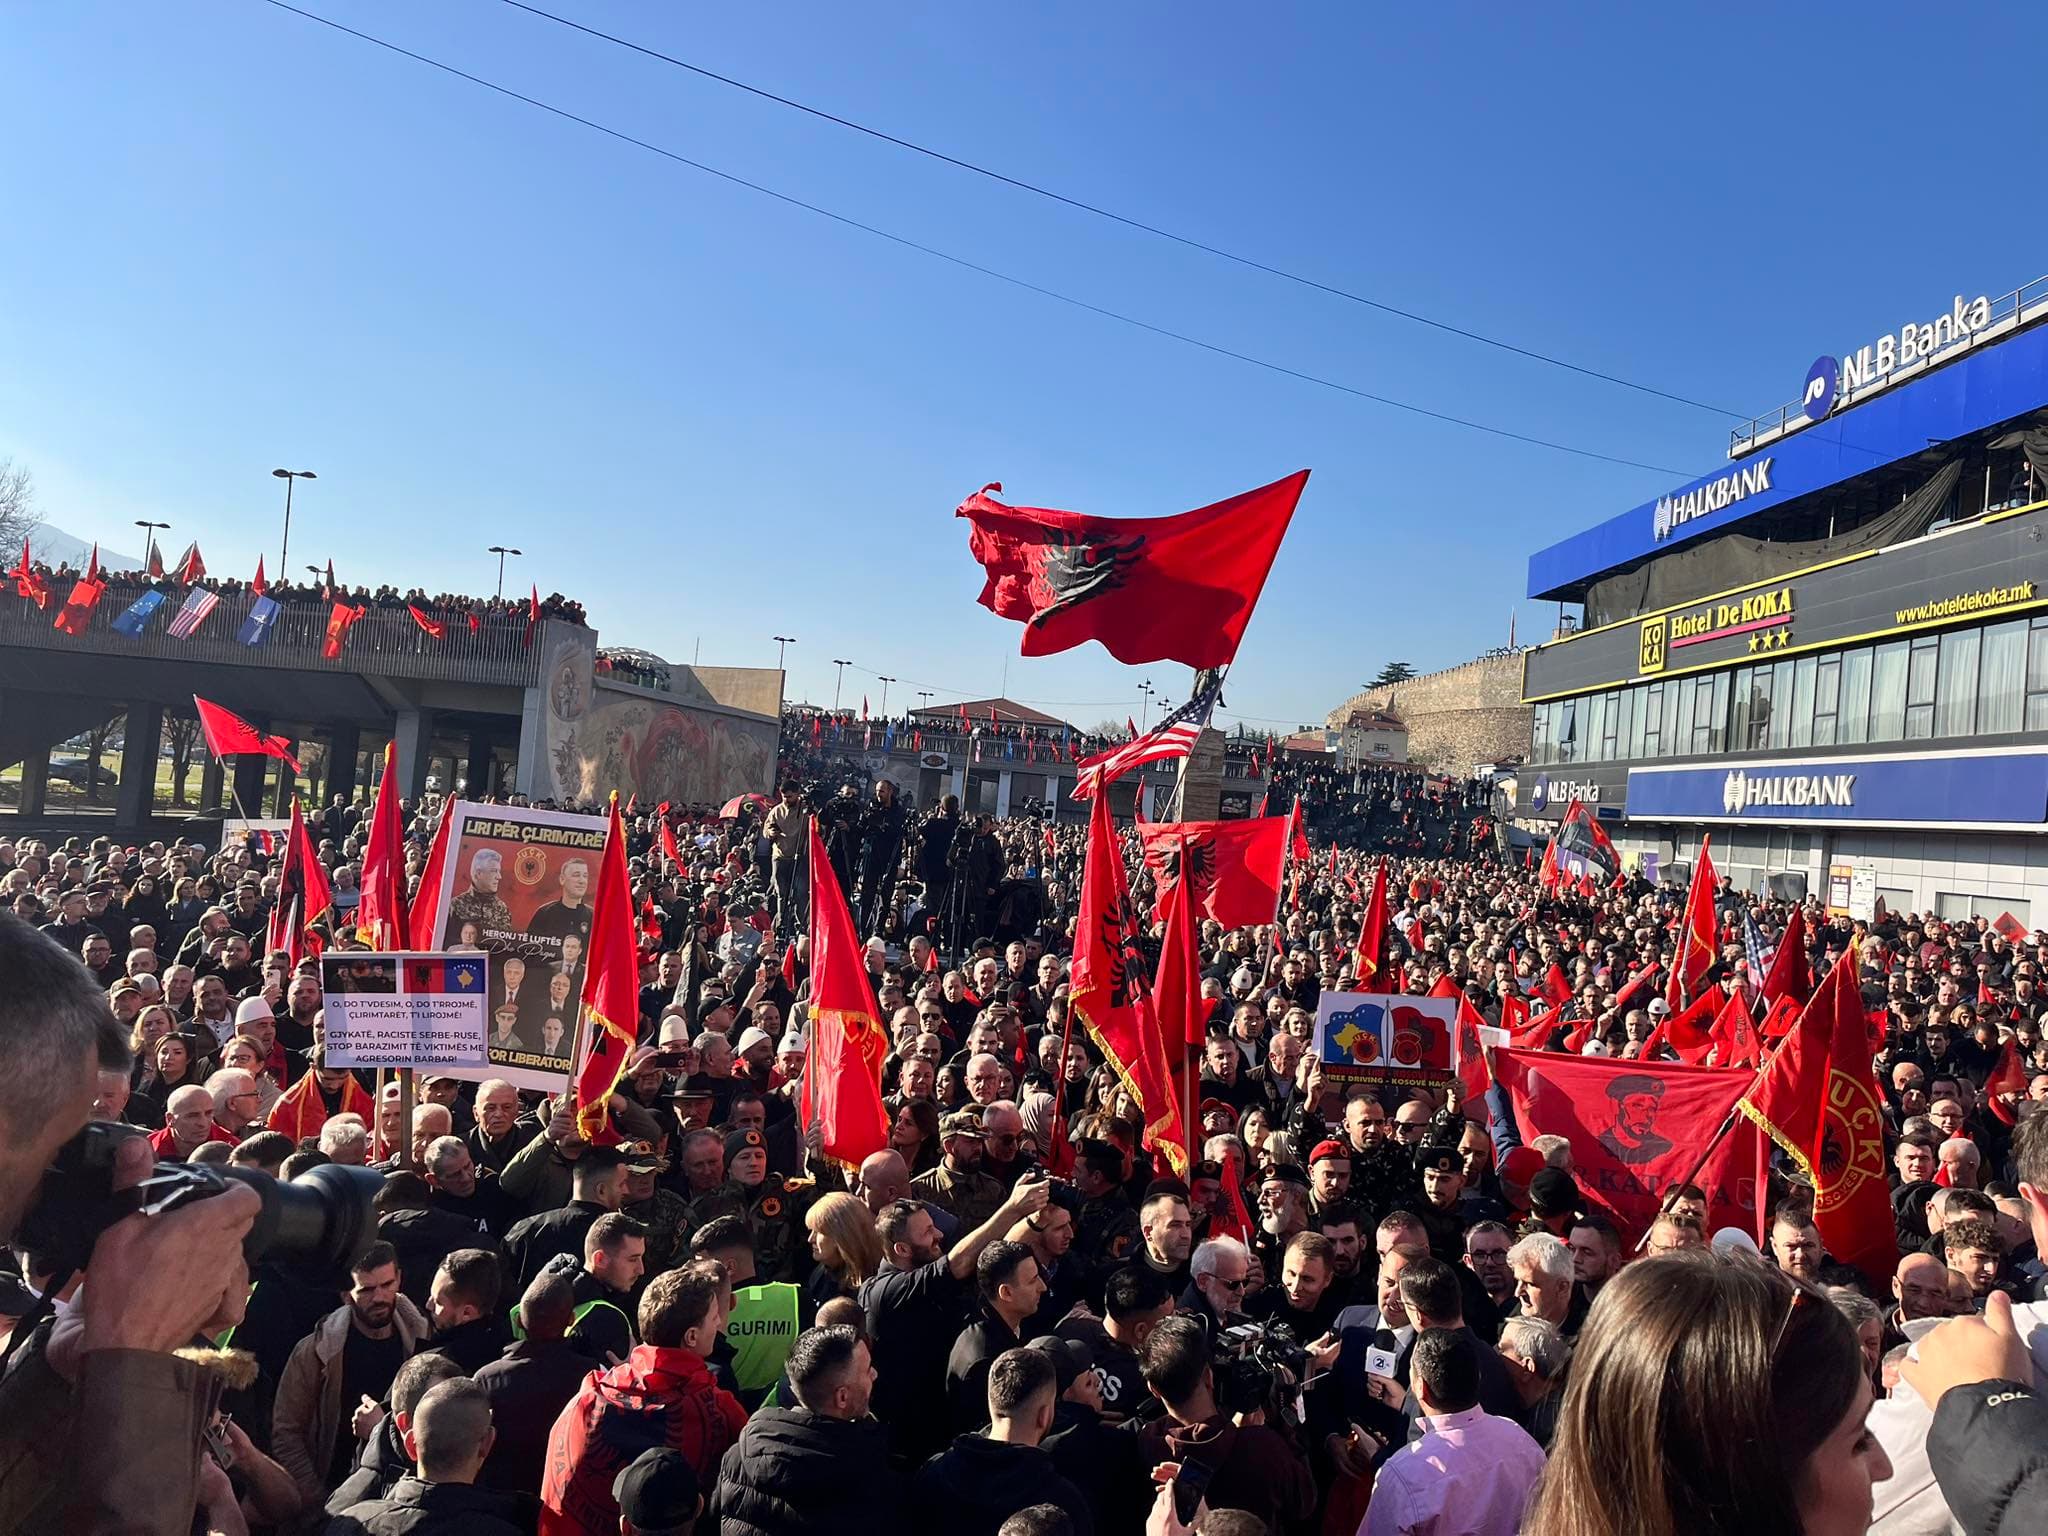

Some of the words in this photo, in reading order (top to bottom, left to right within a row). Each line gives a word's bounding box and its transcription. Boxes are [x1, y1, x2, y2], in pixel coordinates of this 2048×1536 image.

[1842, 334, 1896, 393] NLB
[1900, 295, 1988, 365] Banka
[1671, 456, 1772, 527] HALKBANK
[1895, 580, 2033, 625] www.hoteldekoka.mk
[1670, 608, 1713, 640] Hotel
[1644, 625, 1662, 646] KO
[1643, 646, 1660, 665] KA
[1547, 781, 1568, 803] NLB
[1568, 778, 1600, 802] Banka
[1745, 774, 1854, 806] HALKBANK
[465, 820, 491, 835] LIRI
[493, 821, 520, 839] PËR
[521, 826, 606, 848] ÇLIRIMTARË
[482, 928, 516, 941] HERONJ
[517, 932, 529, 942] TË
[530, 934, 561, 947] LUFTËS
[332, 1000, 342, 1009] O,
[343, 1000, 358, 1008] DO
[405, 1000, 415, 1009] O,
[416, 1000, 430, 1008] DO
[329, 1030, 375, 1039] GJYKATË,
[377, 1031, 417, 1039] RACISTE
[419, 1031, 481, 1040] SERBE-RUSE,
[326, 1042, 353, 1051] STOP
[355, 1042, 408, 1051] BARAZIMIT
[410, 1042, 422, 1051] TË
[424, 1042, 468, 1052] VIKTIMËS
[469, 1044, 485, 1052] ME
[488, 1049, 508, 1062] OR
[355, 1054, 412, 1063] AGRESORIN
[414, 1055, 457, 1063] BARBAR!
[1348, 1075, 1384, 1084] DRIVING
[1830, 1079, 1881, 1163] UÇK
[727, 1320, 792, 1337] GURIMI
